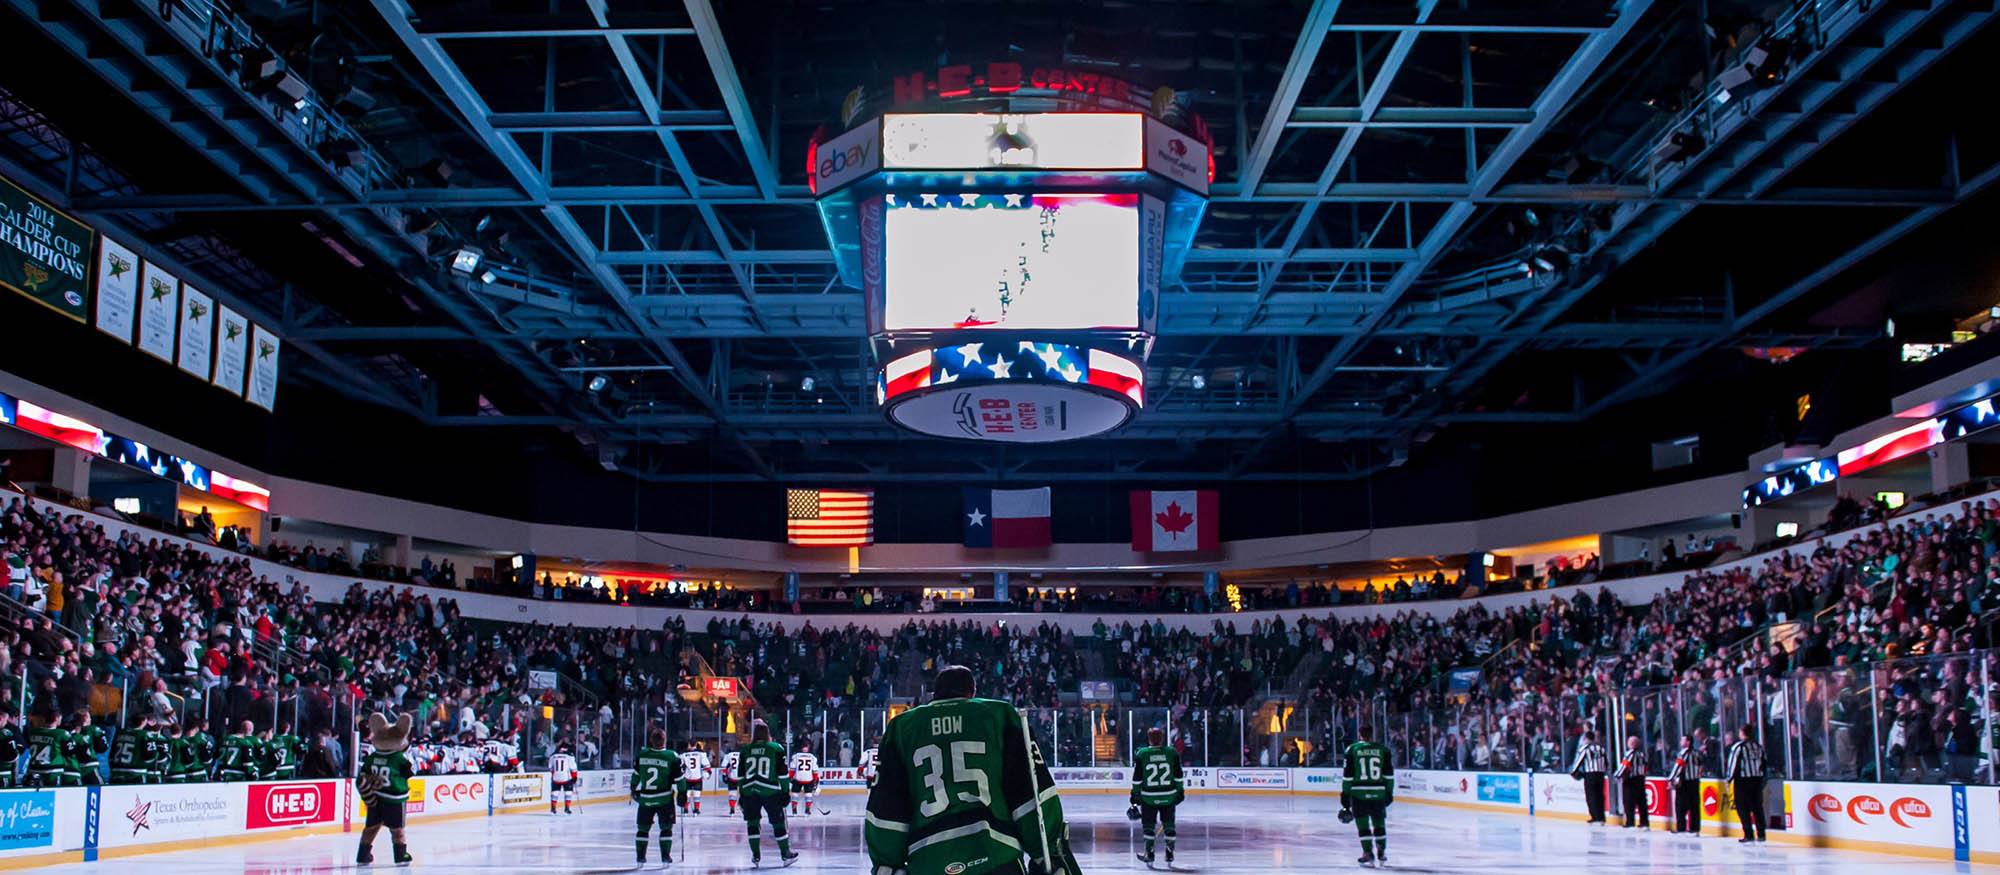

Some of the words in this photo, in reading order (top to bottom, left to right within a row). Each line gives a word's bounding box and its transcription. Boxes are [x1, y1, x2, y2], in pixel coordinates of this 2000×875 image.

[1032, 67, 1130, 99] CENTER
[820, 138, 873, 178] ebay
[27, 201, 55, 229] 2014
[0, 221, 85, 281] HAMPIONS
[54, 235, 81, 258] CUP
[1147, 208, 1157, 285] SUBARU
[1017, 402, 1038, 430] CENTER
[931, 715, 962, 736] BOW
[555, 760, 564, 772] 11
[690, 758, 697, 770] 3
[744, 757, 771, 780] 20
[798, 760, 811, 771] 25
[820, 770, 843, 780] JEFF
[846, 771, 854, 780] &
[1145, 763, 1172, 787] 22
[1359, 757, 1381, 780] 16
[645, 767, 659, 790] 2
[913, 740, 992, 818] 35
[154, 800, 180, 814] Texas
[180, 797, 228, 813] Orthopedics
[1859, 798, 1880, 811] ufcu
[1903, 800, 1927, 814] ufcu
[87, 792, 98, 844] CCM
[1955, 791, 1967, 844] CCM
[967, 856, 988, 867] CCM
